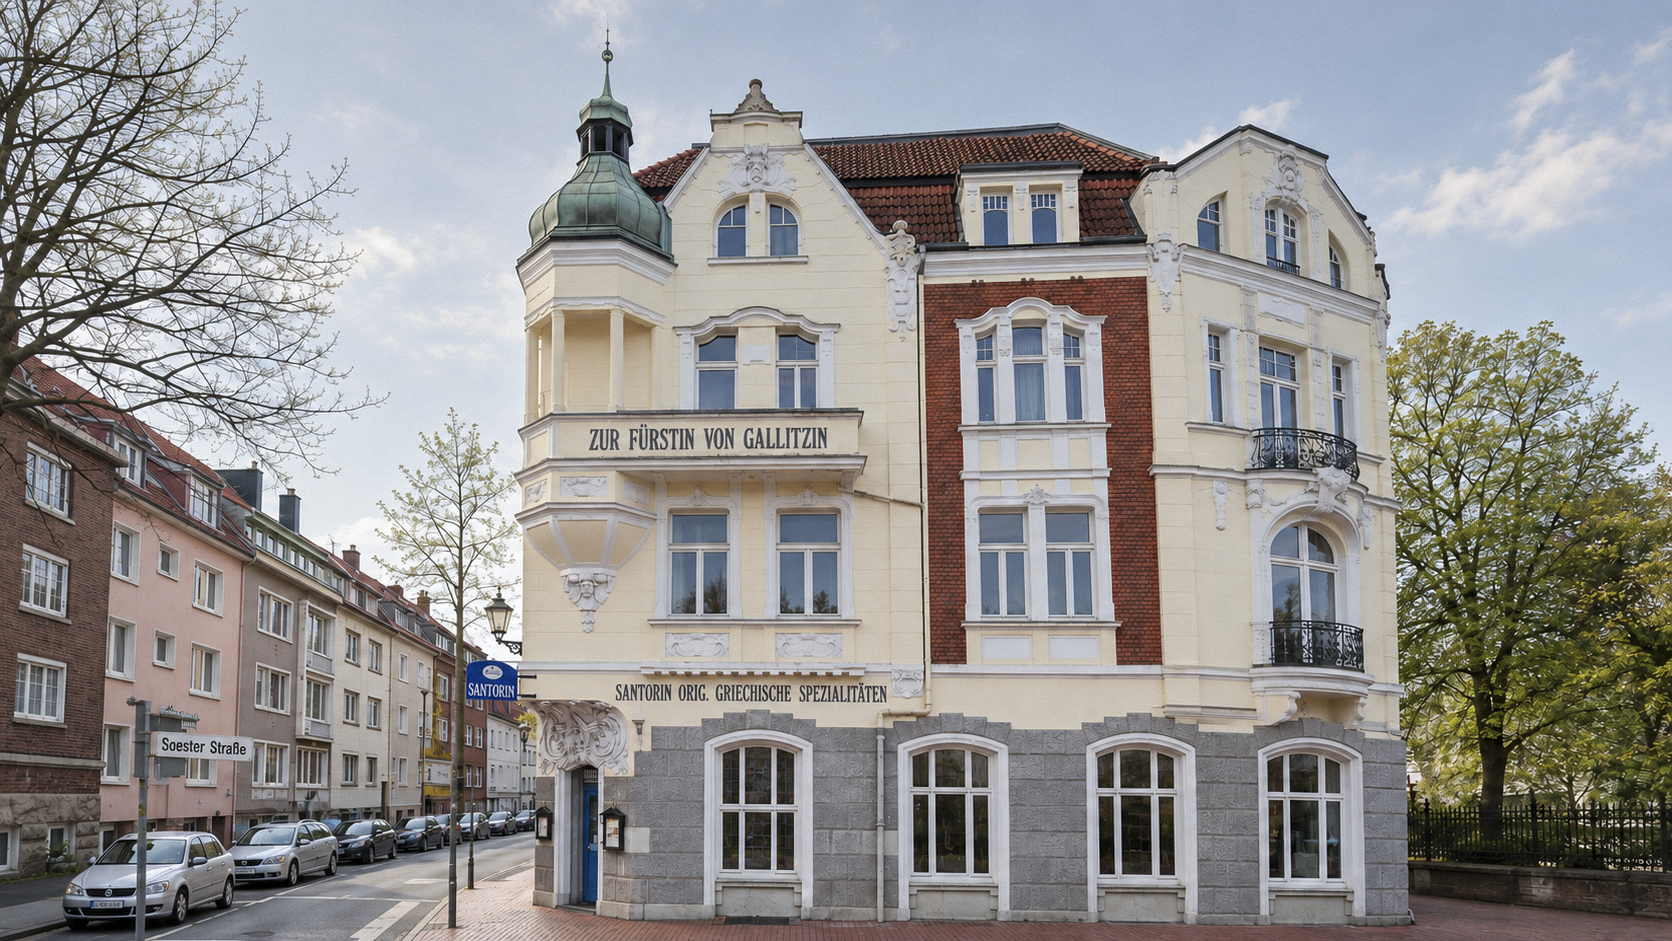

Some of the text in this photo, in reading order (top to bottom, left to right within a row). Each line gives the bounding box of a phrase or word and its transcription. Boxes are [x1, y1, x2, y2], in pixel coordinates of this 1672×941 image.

[589, 424, 828, 451] ZUR FÜRSTIN VON GALLITZIN
[468, 682, 515, 699] SANTORIN
[615, 682, 887, 704] SANTORIN ORIG. GRIECHISCHE SPEZIALITÄTEN
[161, 737, 247, 756] Soester Straße
